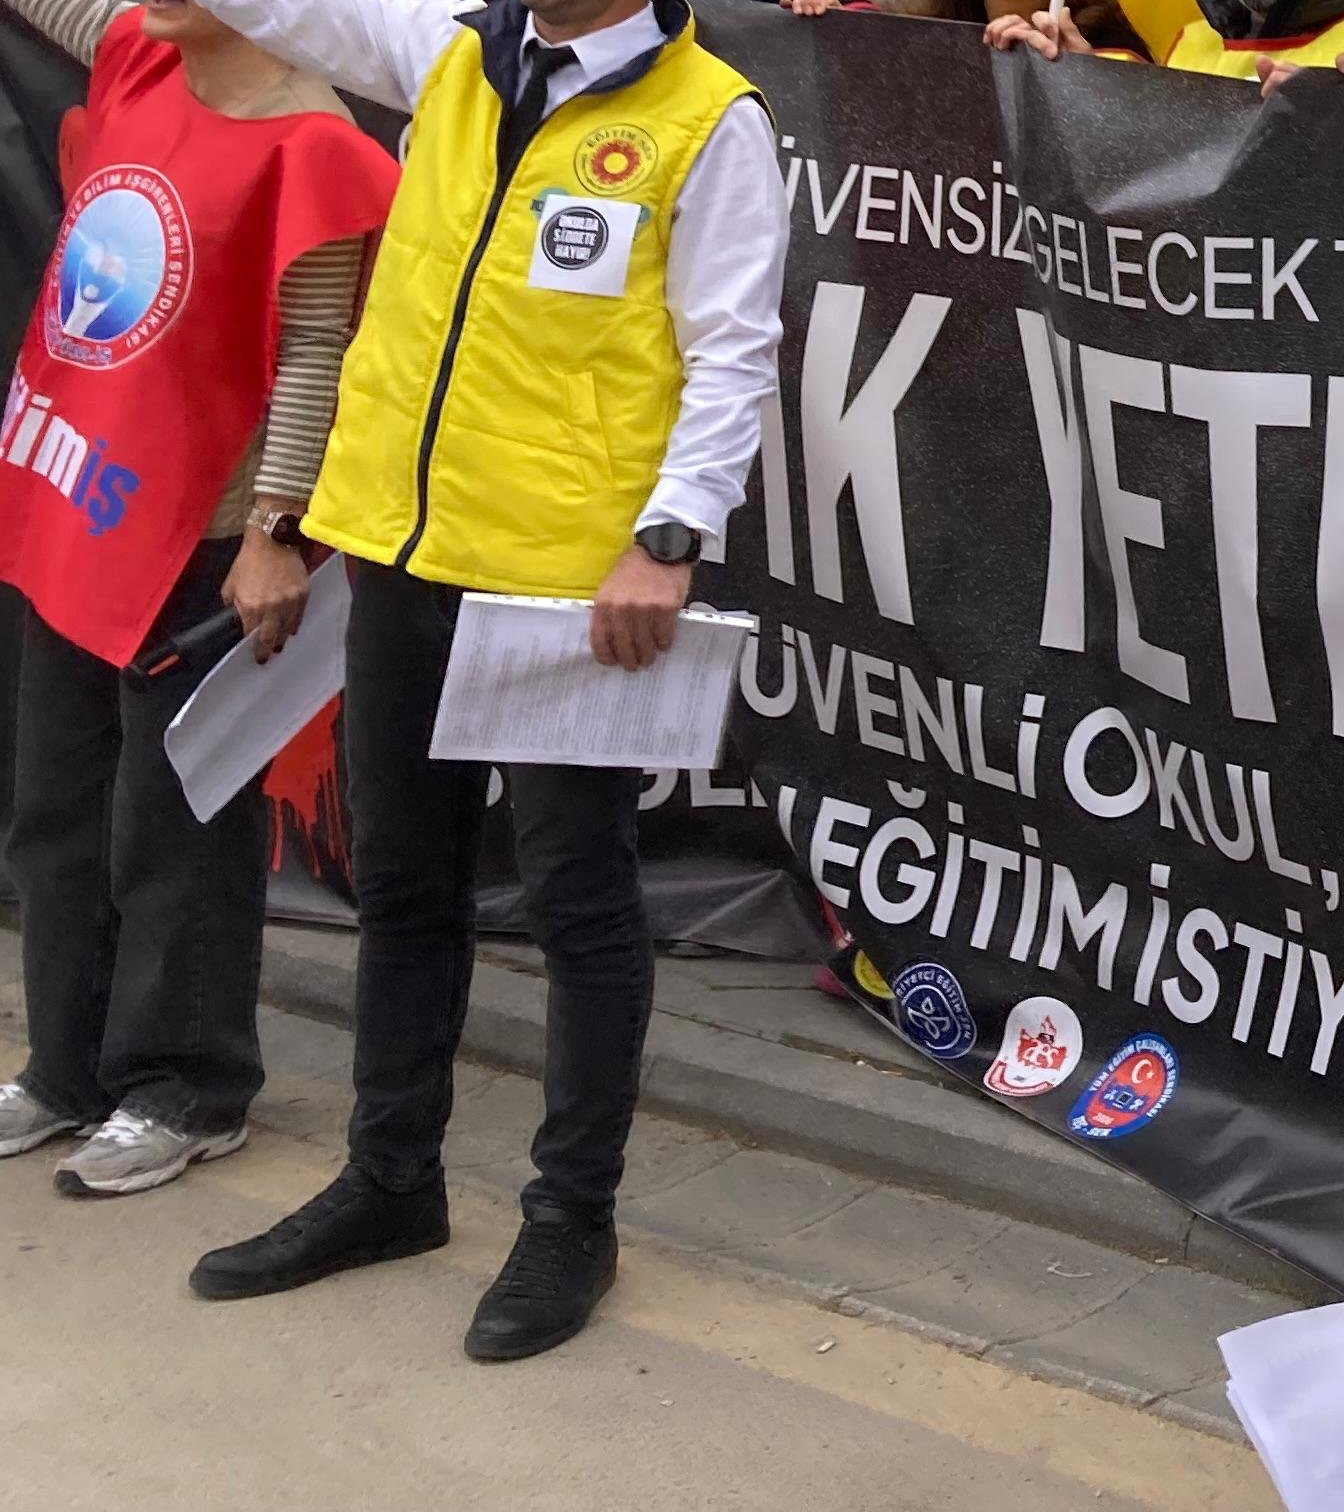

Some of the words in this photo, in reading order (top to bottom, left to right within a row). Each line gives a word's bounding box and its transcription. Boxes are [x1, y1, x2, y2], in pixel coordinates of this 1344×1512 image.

[1026, 209, 1320, 324] GELECEK
[810, 780, 1129, 994] EĞİTİM
[1062, 704, 1342, 913] OKUL,
